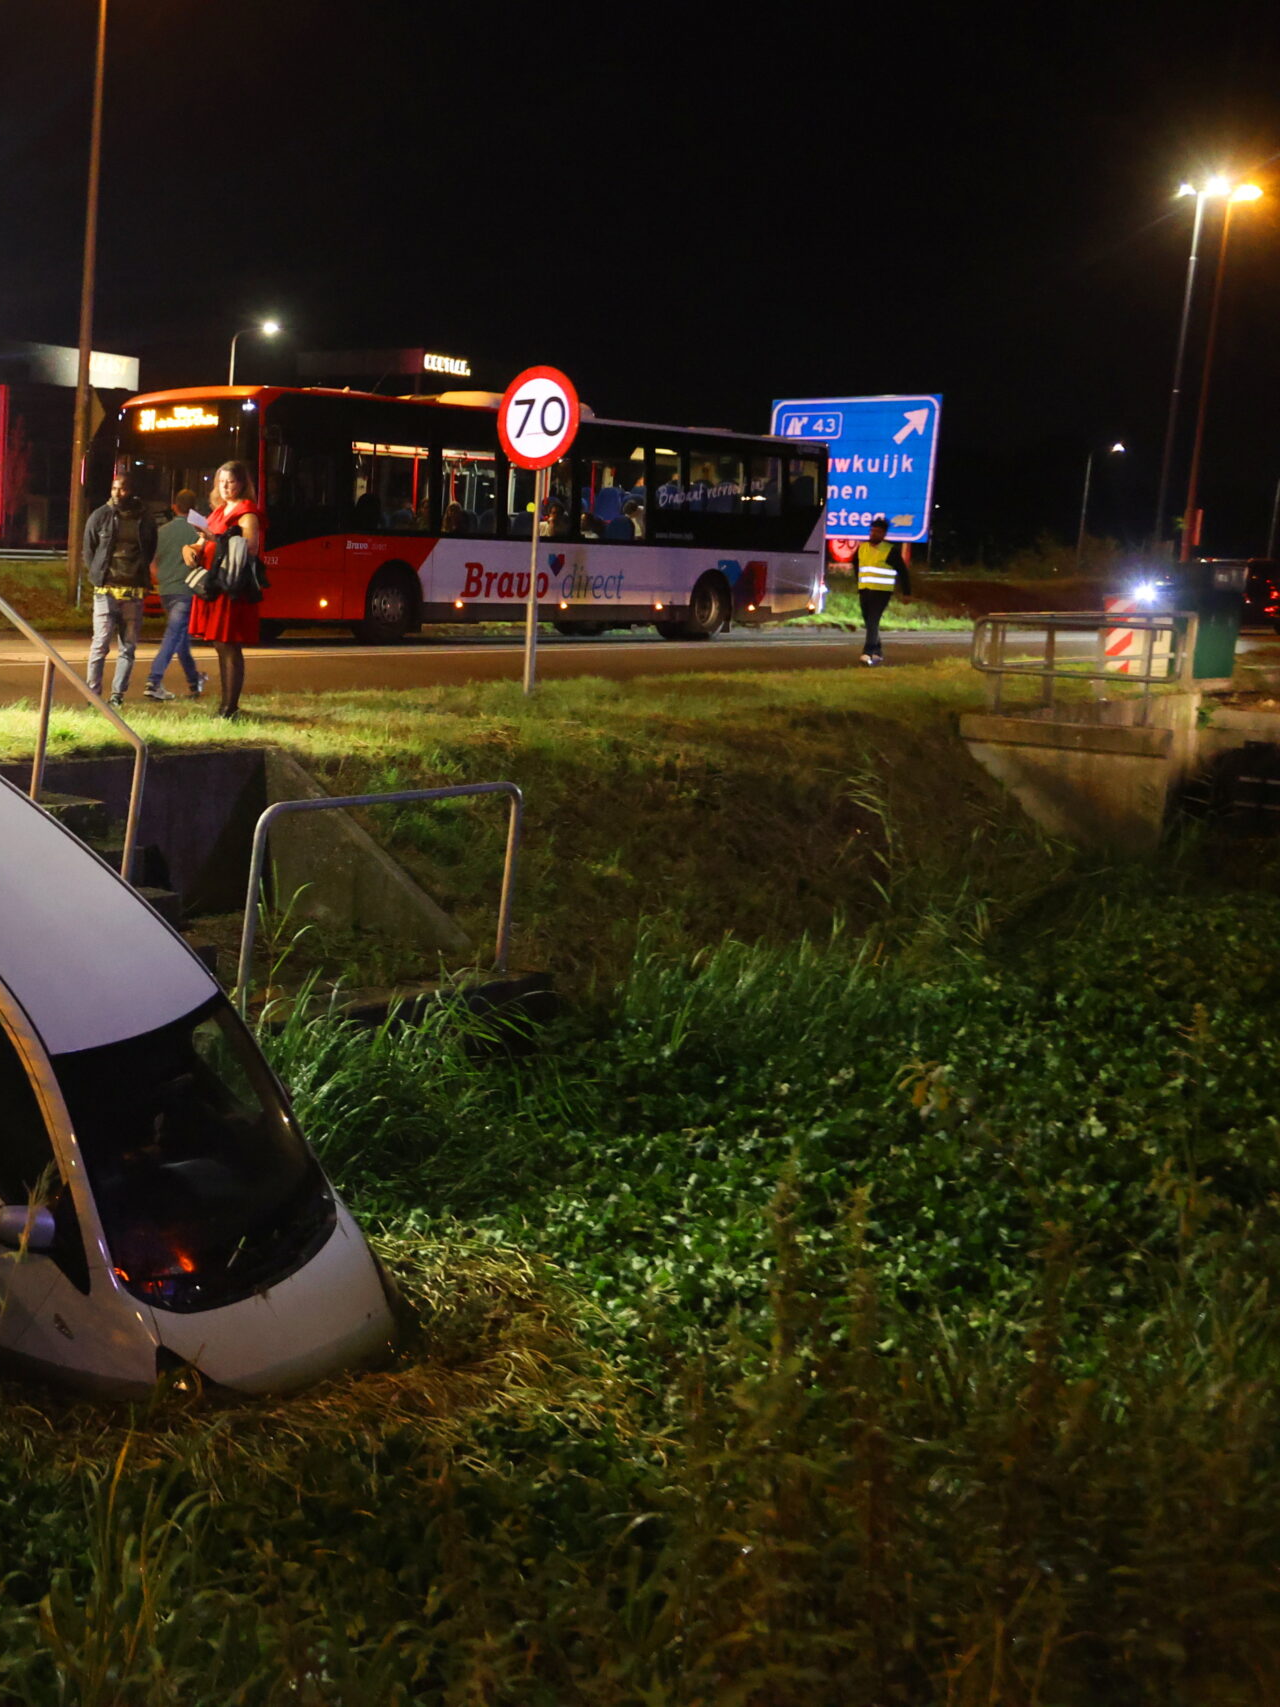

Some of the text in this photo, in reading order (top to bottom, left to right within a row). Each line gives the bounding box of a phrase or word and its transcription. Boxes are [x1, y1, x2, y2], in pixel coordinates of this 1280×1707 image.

[514, 396, 565, 438] 70
[812, 418, 836, 433] 43
[345, 540, 369, 550] Bravo
[460, 562, 624, 599] Bravo direct
